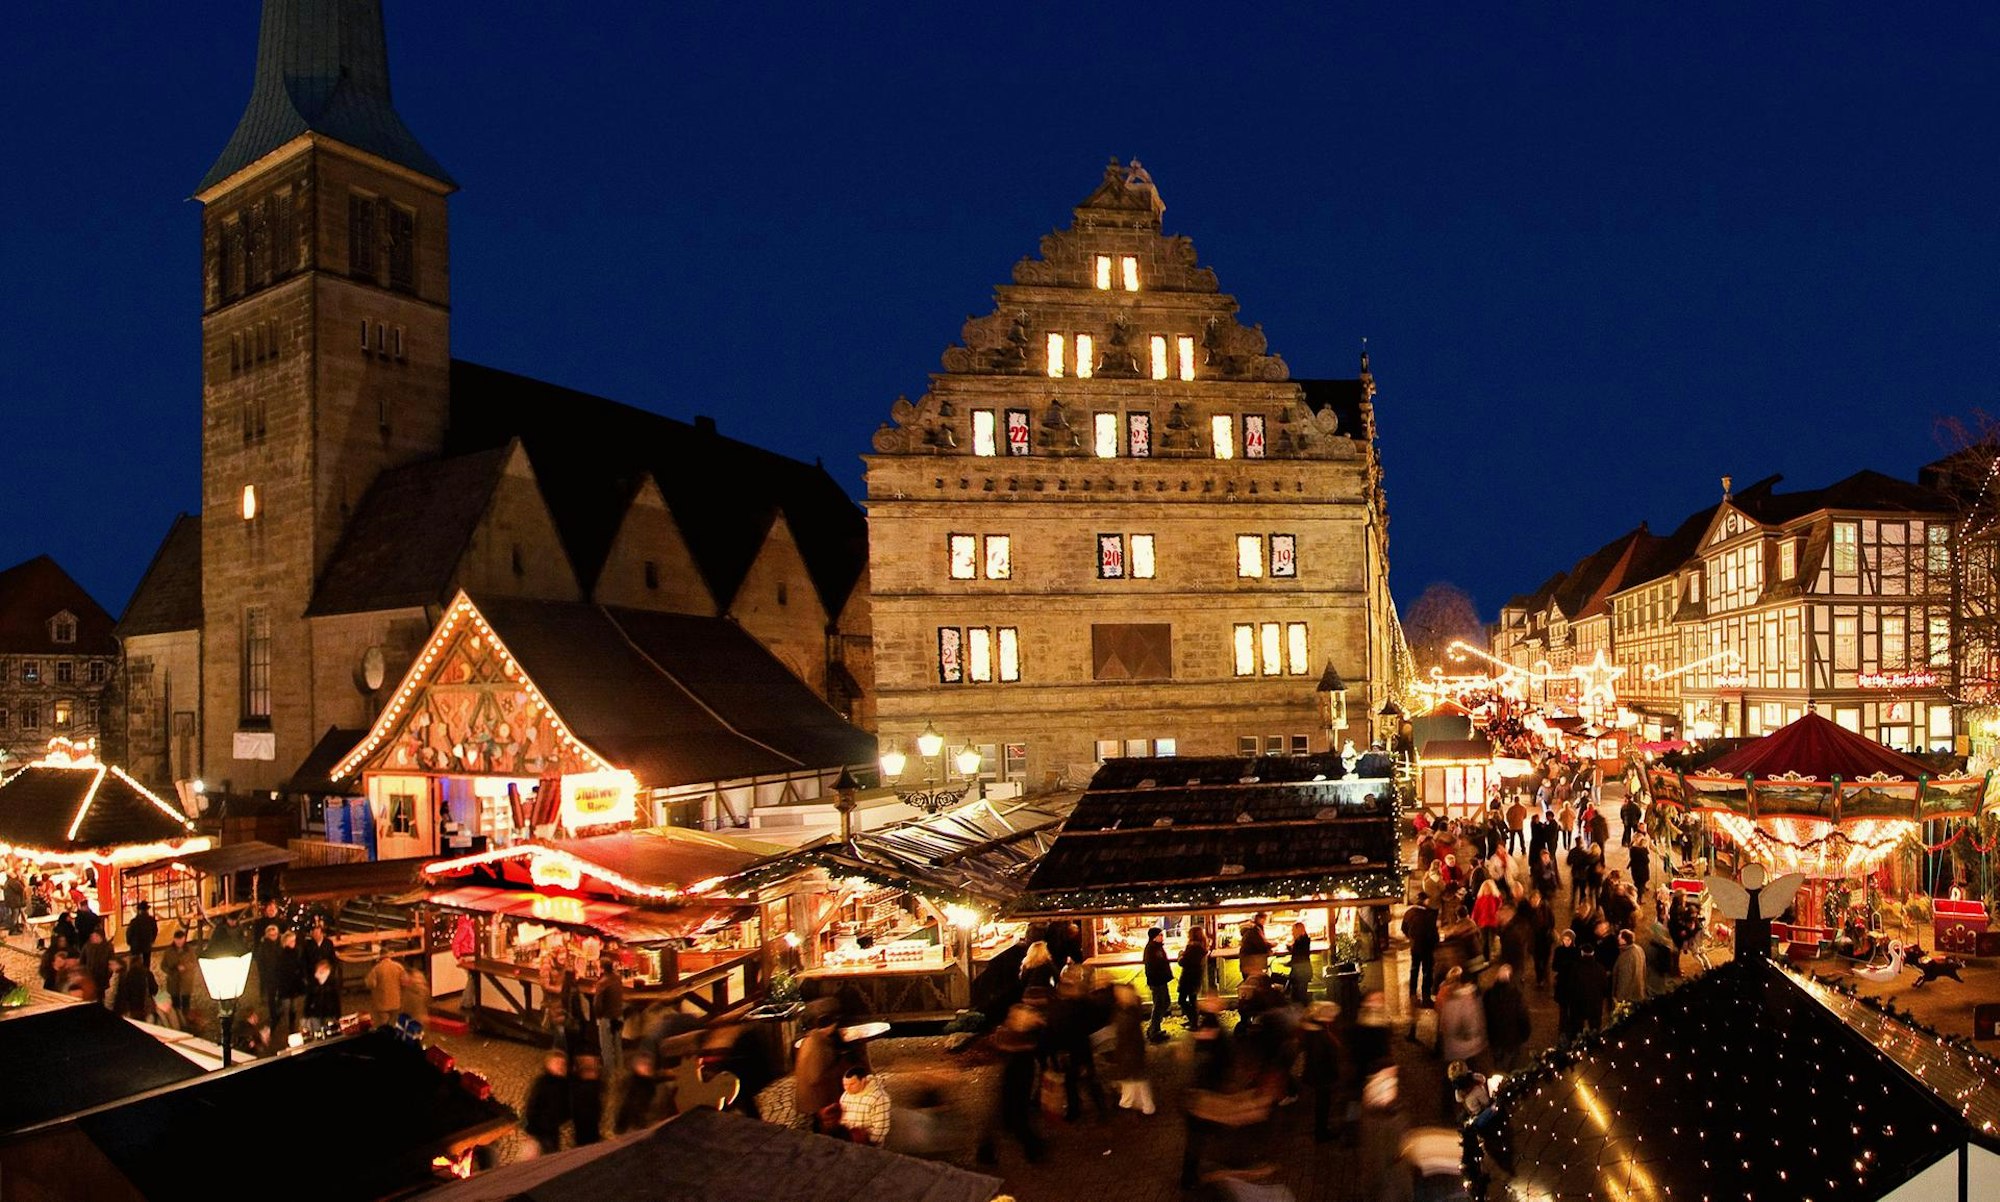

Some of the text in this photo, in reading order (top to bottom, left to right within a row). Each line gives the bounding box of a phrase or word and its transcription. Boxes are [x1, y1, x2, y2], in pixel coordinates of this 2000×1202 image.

[1011, 425, 1027, 443] 22
[1133, 429, 1148, 444] 23
[1104, 549, 1119, 567] 20
[1277, 549, 1291, 566] 19
